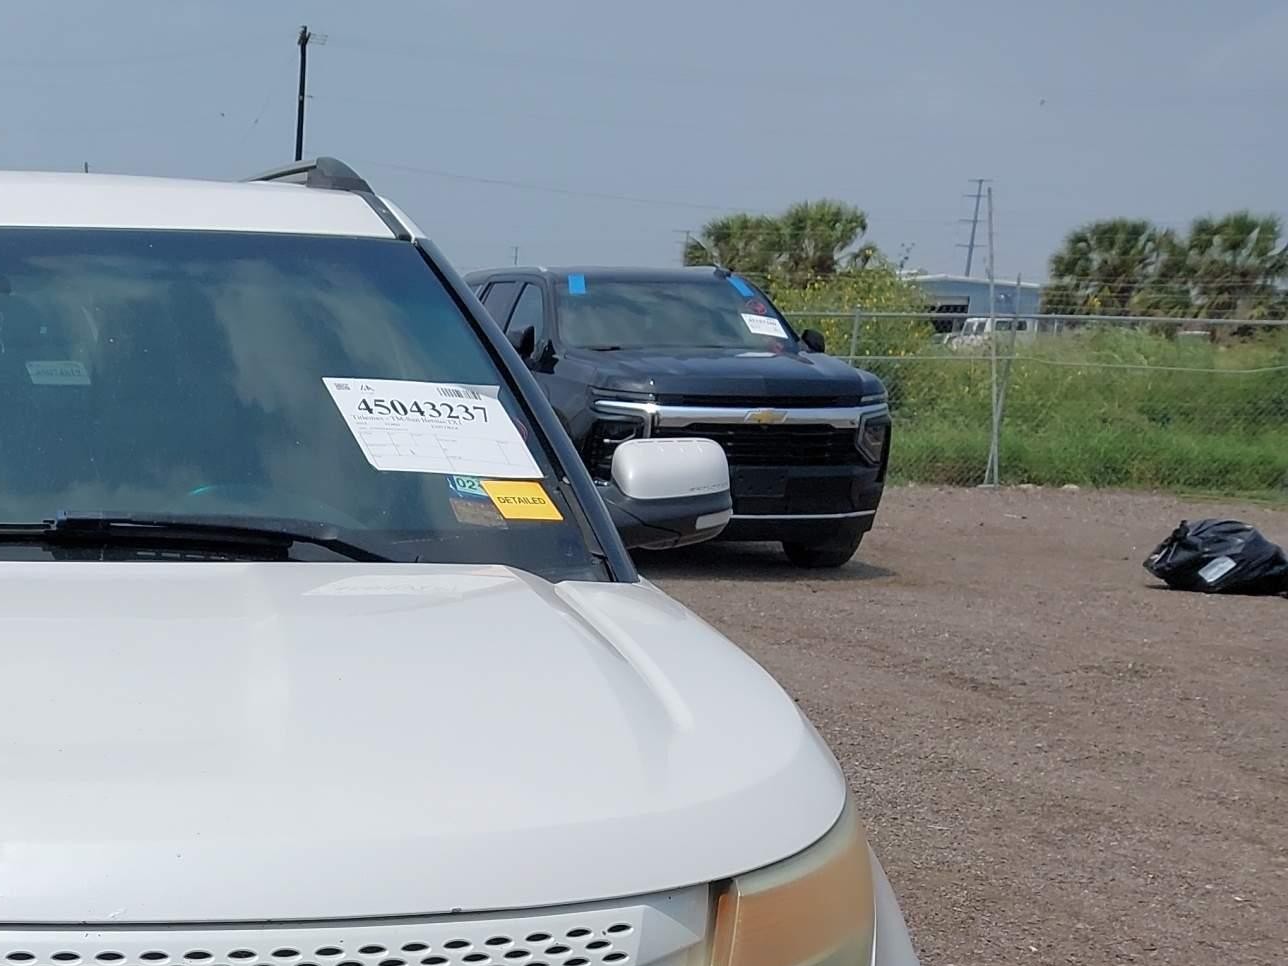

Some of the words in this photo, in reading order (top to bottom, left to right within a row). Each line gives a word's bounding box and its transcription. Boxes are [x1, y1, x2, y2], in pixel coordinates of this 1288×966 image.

[357, 398, 489, 423] 45043237
[456, 478, 478, 490] 02
[497, 496, 547, 505] DETAILED
